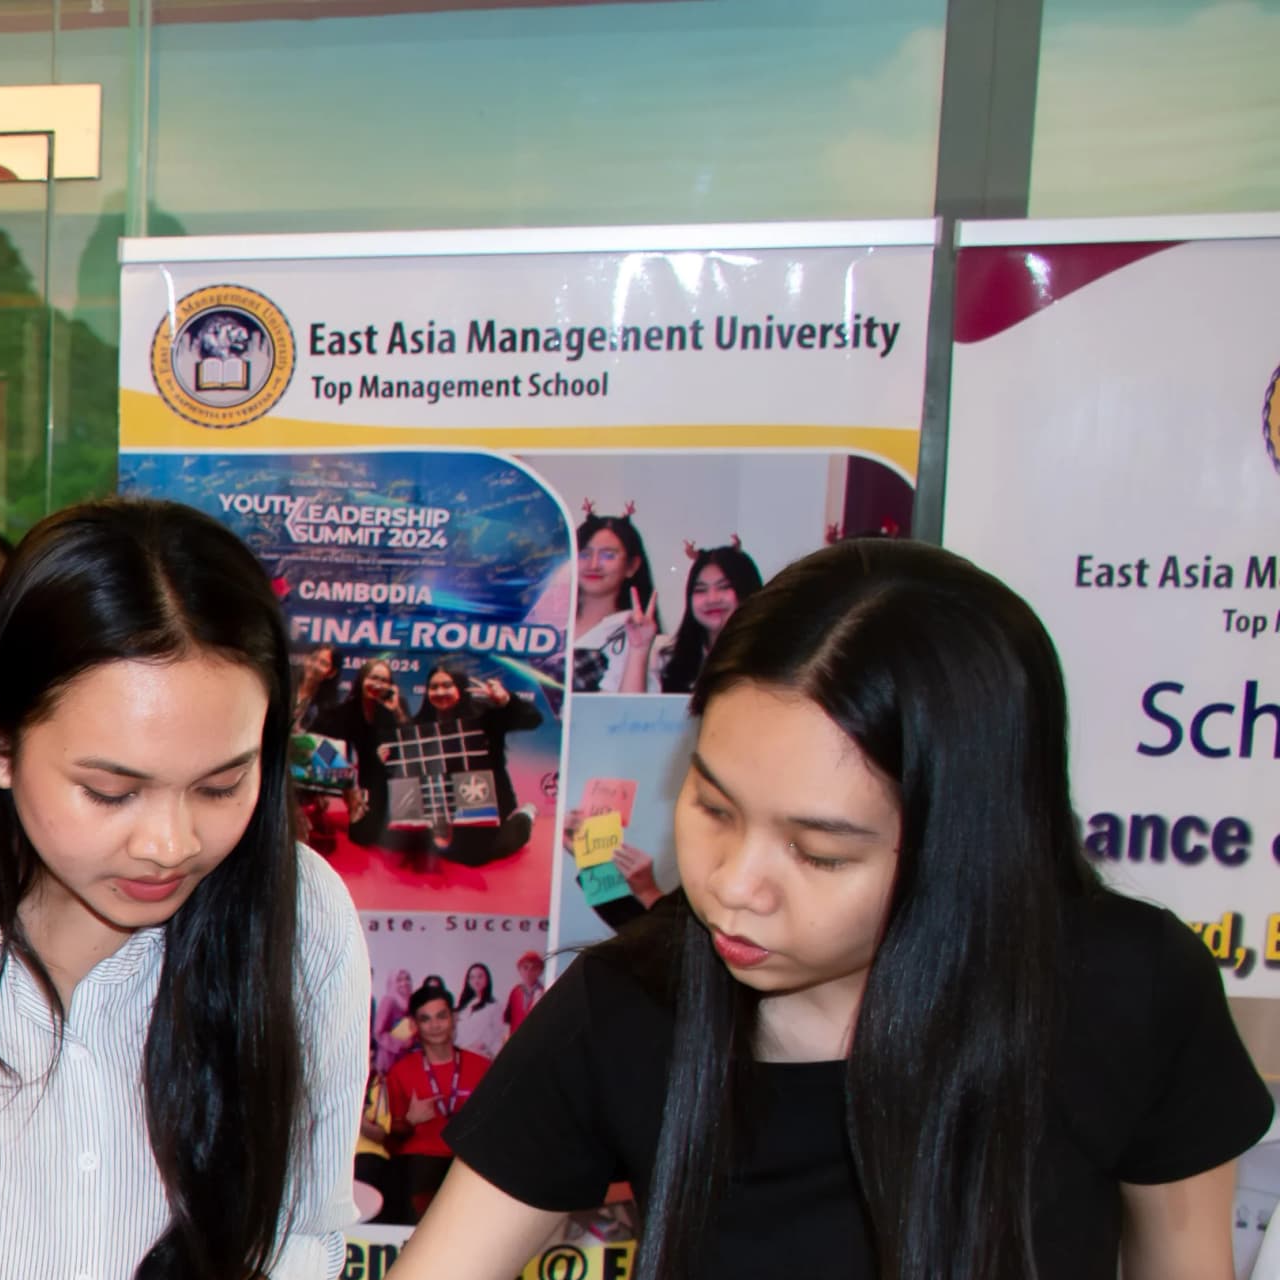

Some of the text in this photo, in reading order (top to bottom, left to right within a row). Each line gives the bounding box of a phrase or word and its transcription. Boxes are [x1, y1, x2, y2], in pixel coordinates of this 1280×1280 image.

[309, 322, 378, 356] East
[387, 319, 457, 355] Asia
[714, 313, 901, 358] University
[311, 370, 609, 405] Top Management School
[219, 493, 298, 515] YOUTH
[294, 499, 451, 529] LEADERSHIP
[294, 525, 449, 549] SUMMIT 2024
[1074, 555, 1280, 590] East Asia M
[298, 580, 433, 606] CAMBODIA
[291, 616, 558, 653] FINAL ROUND
[1222, 608, 1268, 639] Top
